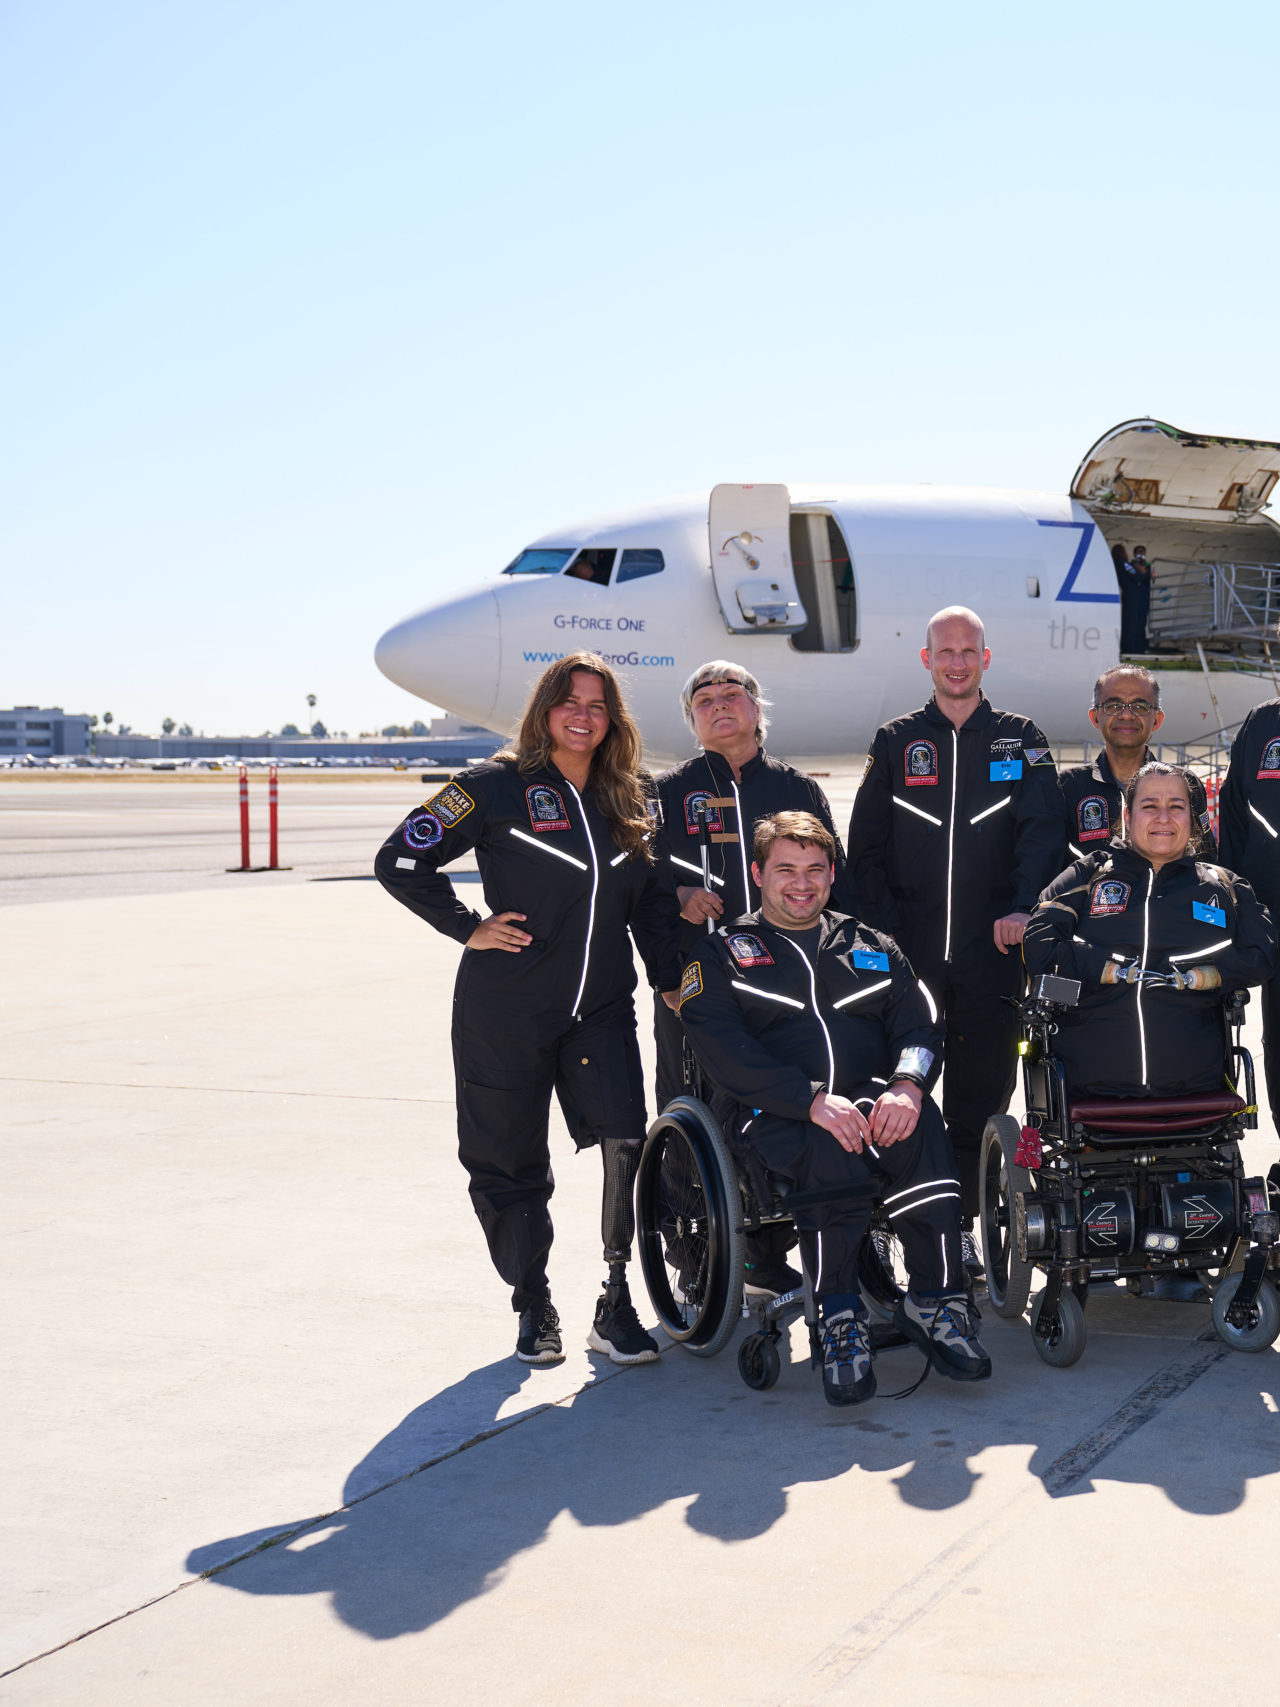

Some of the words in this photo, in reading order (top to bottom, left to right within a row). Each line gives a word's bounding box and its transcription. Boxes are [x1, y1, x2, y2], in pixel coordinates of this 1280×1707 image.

[1047, 614, 1102, 651] the
[441, 795, 464, 816] SPACE
[448, 788, 471, 809] MAKE
